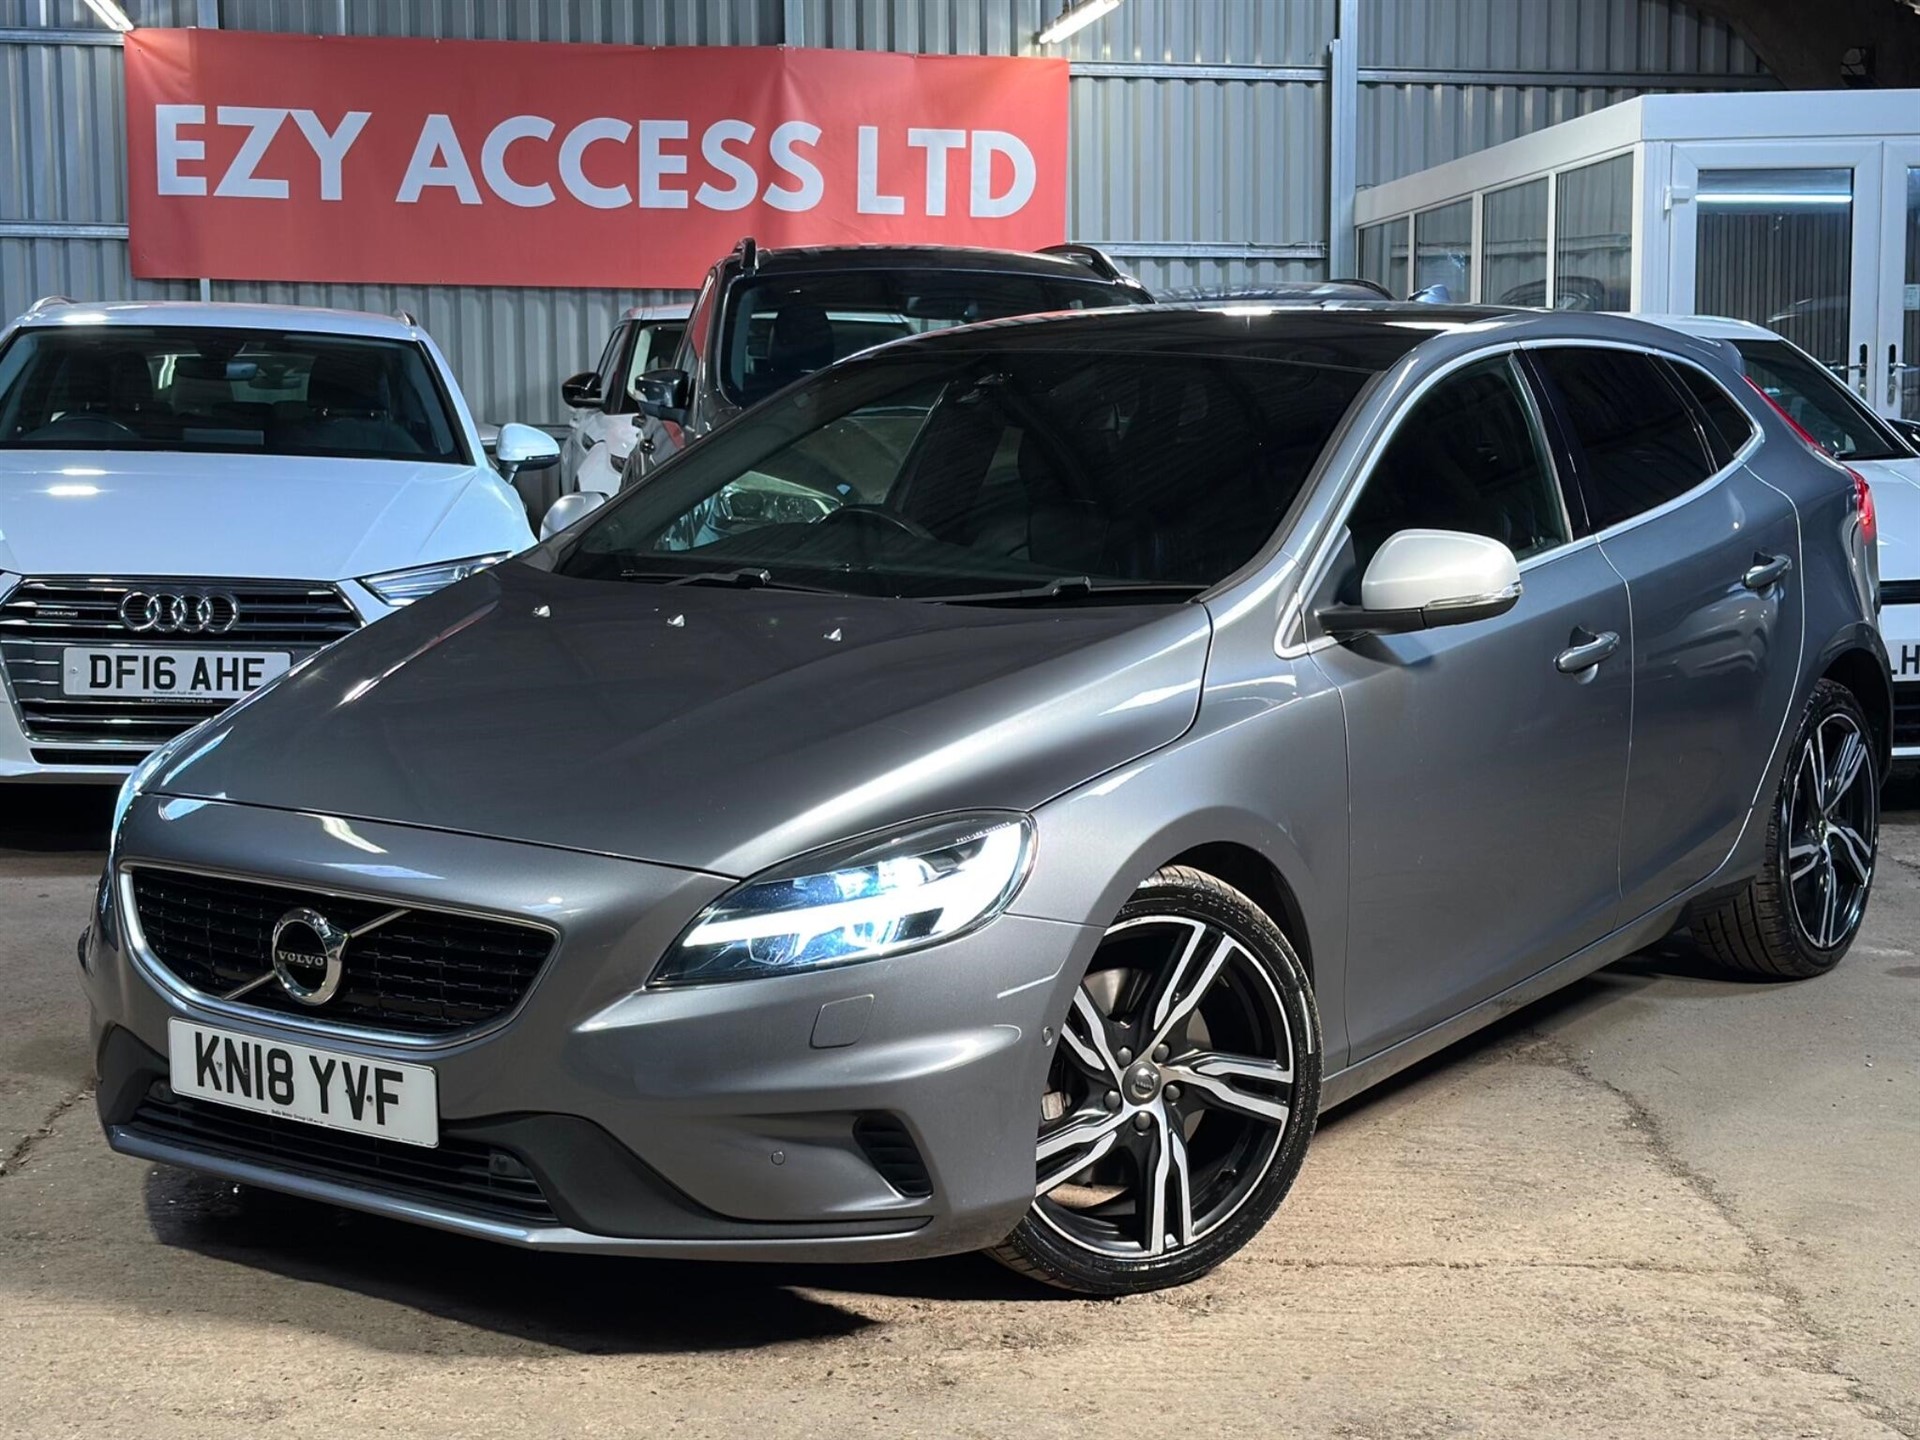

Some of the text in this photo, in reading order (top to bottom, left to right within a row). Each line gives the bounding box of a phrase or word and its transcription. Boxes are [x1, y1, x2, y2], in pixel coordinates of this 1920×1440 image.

[155, 103, 1037, 218] EZY ACCESS LTD
[89, 654, 265, 691] DF16 AHE
[277, 949, 324, 967] VOLVO
[195, 1031, 403, 1126] KN18 YVF
